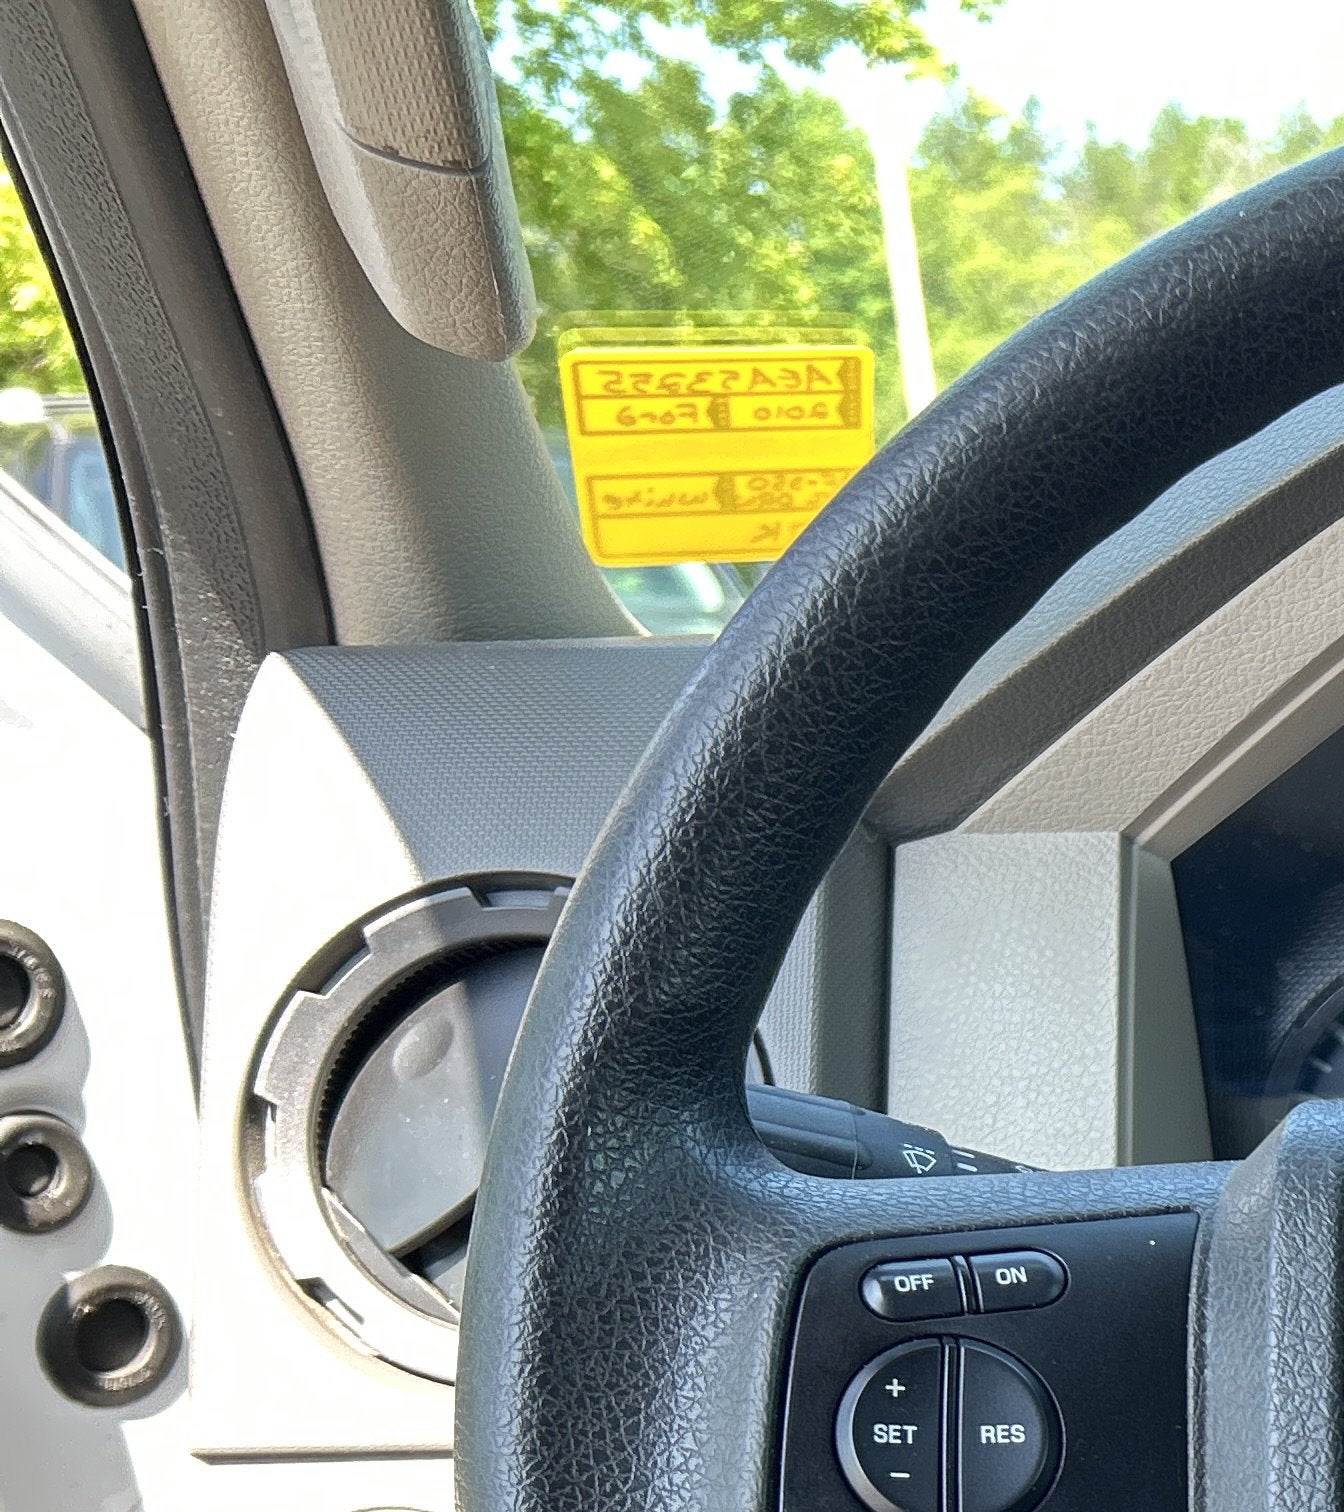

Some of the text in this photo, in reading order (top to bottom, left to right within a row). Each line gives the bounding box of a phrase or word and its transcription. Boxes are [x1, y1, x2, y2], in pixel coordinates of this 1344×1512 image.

[892, 1272, 935, 1293] OFF
[994, 1266, 1028, 1286] ON
[872, 1423, 918, 1445] SET
[980, 1423, 1026, 1444] RES
